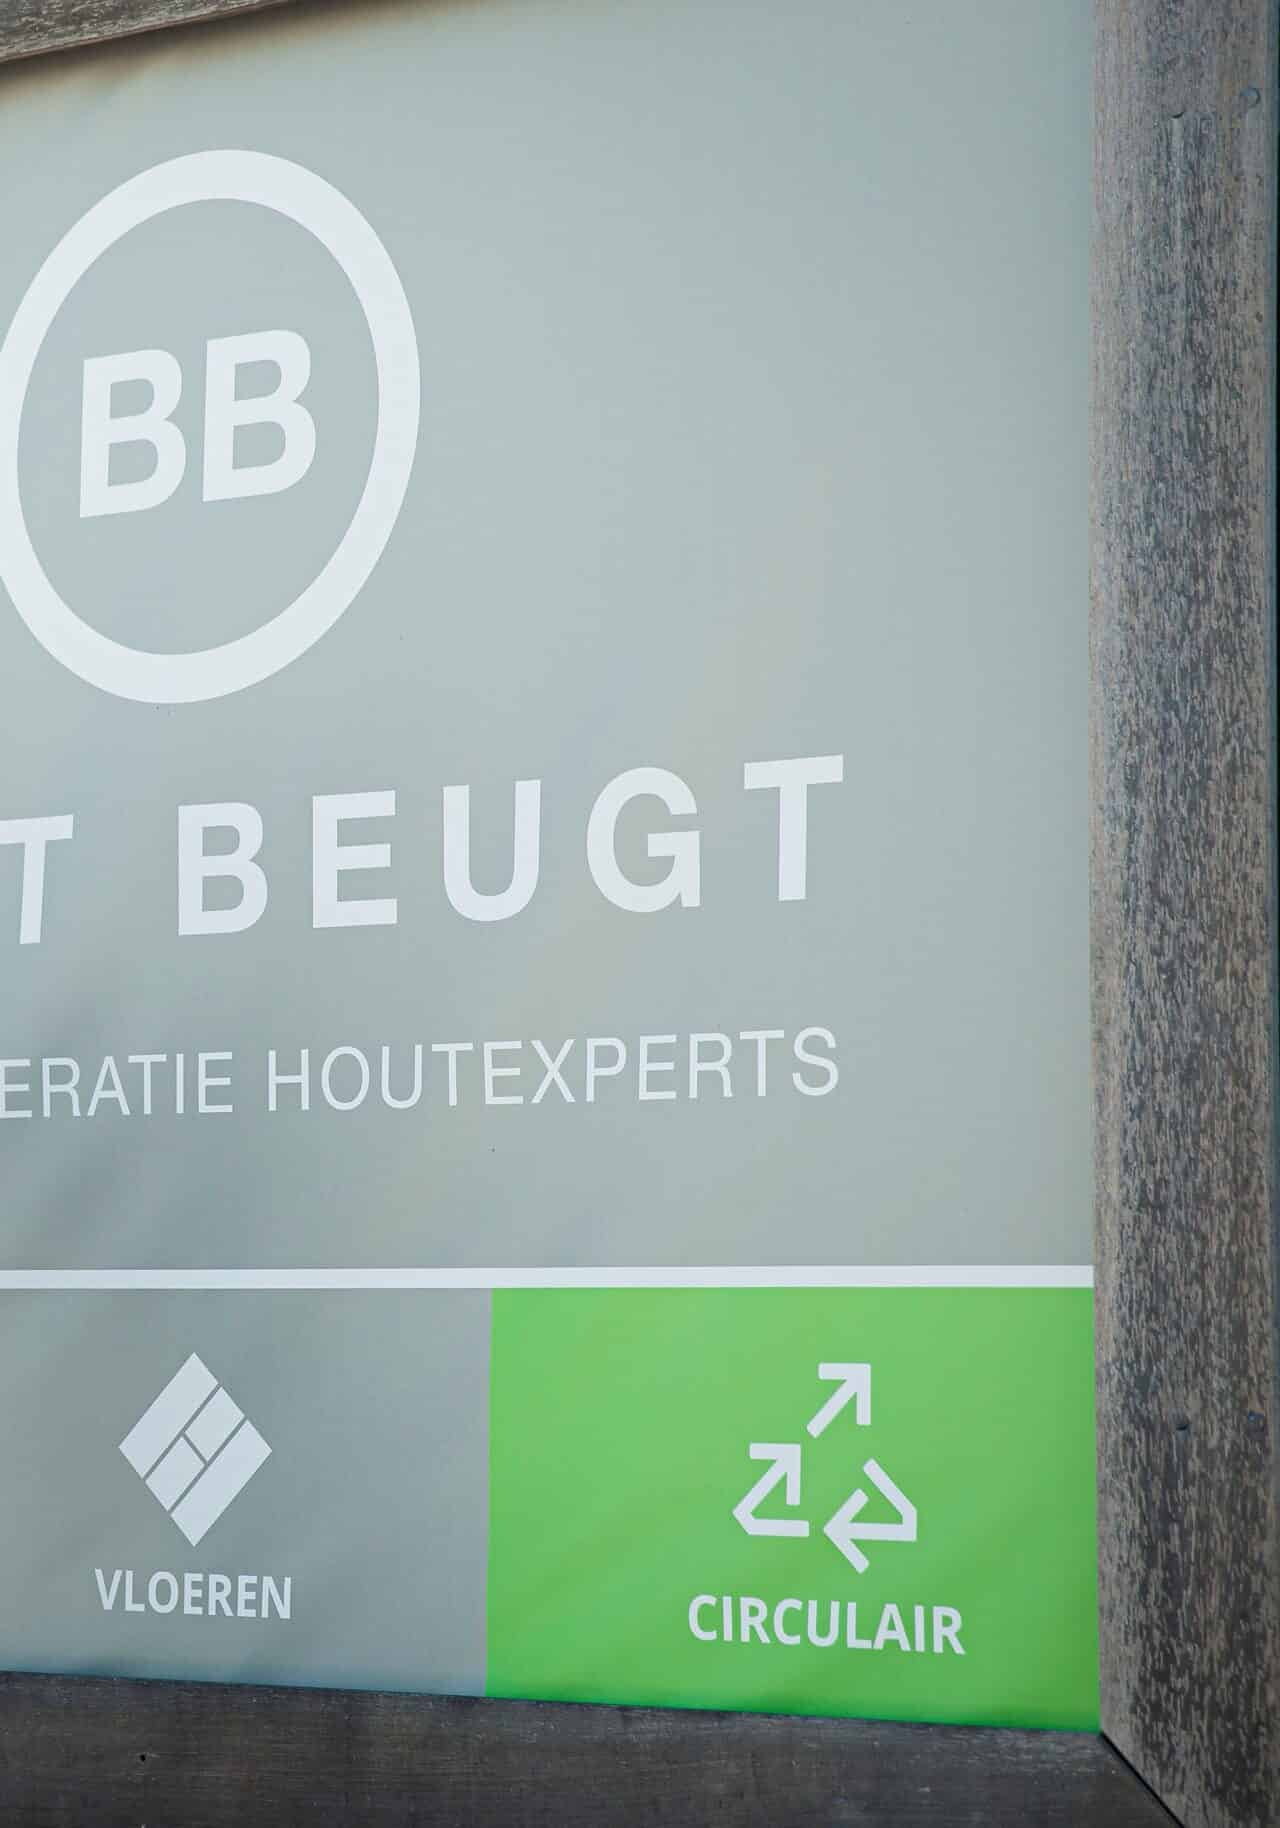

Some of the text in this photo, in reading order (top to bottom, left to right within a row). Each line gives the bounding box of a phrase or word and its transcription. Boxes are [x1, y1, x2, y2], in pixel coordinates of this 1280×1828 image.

[79, 329, 317, 519] BB
[177, 754, 844, 936] BEUGT
[267, 1026, 839, 1112] HOUTEXPERTS
[94, 1567, 292, 1620] VLOEREN
[687, 1594, 967, 1656] CIRCULAIR
